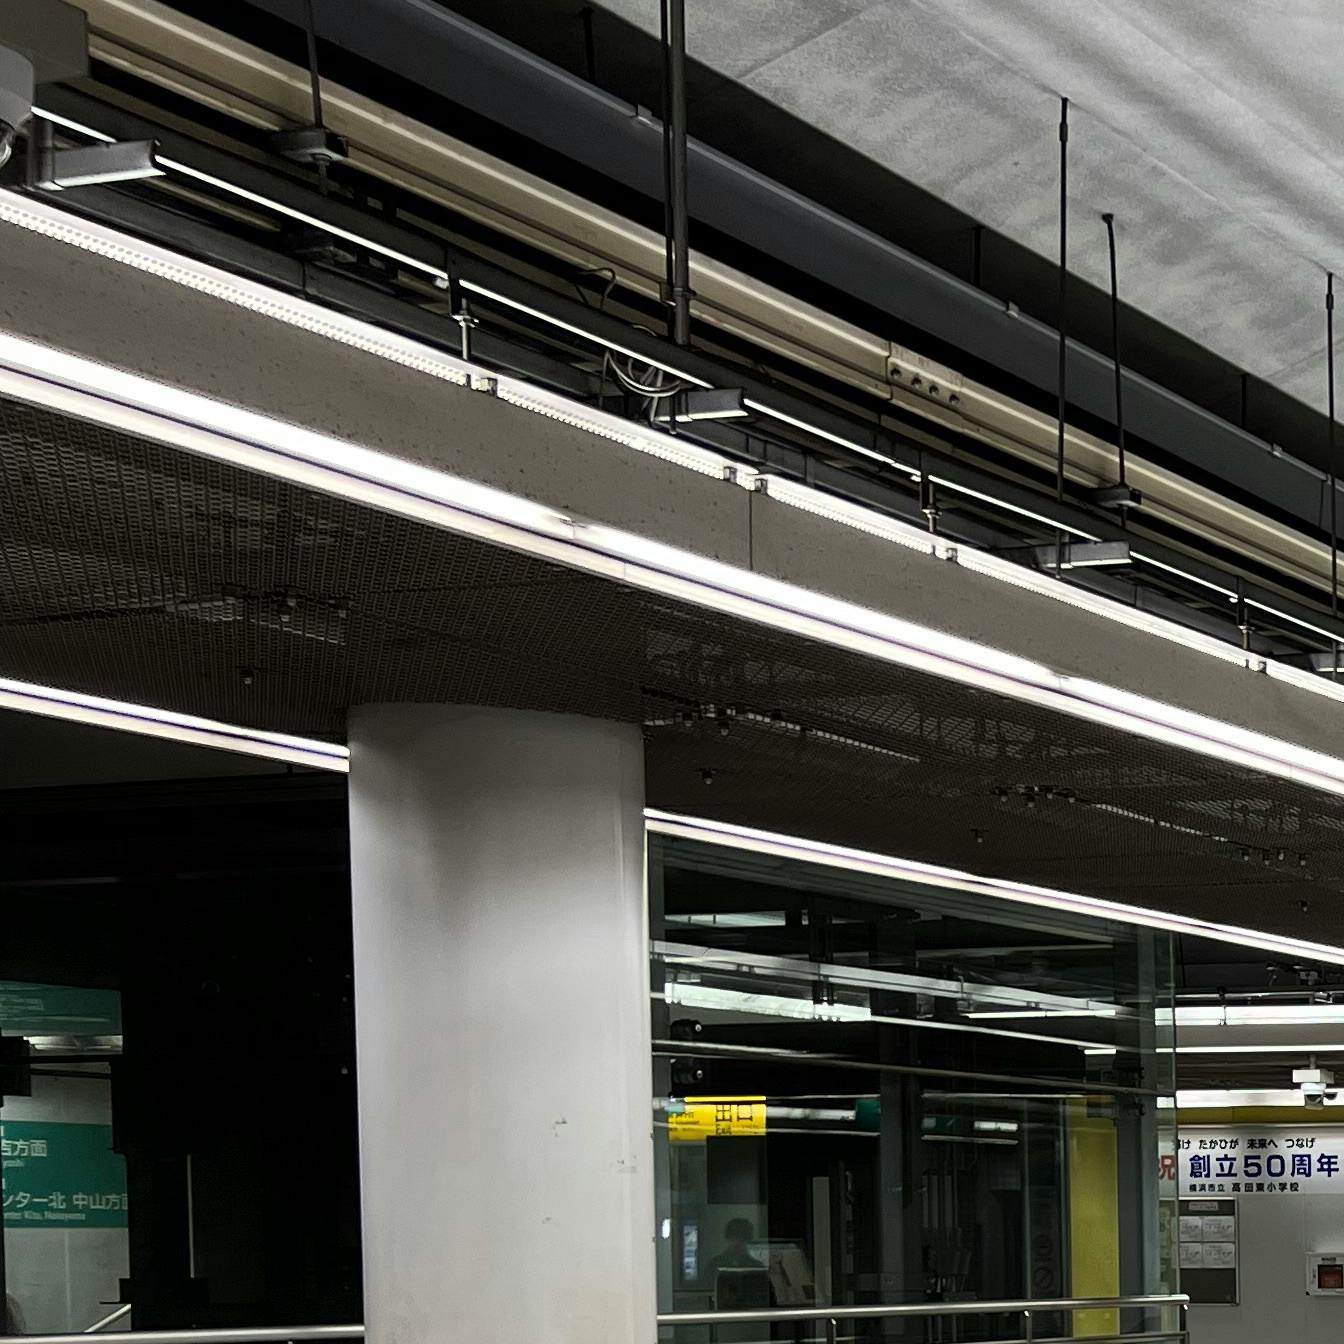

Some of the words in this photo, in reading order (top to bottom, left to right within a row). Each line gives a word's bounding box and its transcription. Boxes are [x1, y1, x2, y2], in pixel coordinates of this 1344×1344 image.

[1199, 1138, 1239, 1150] たかひが
[1247, 1138, 1278, 1150] 未来へ
[1285, 1137, 1315, 1149] つなげ
[1189, 1153, 1339, 1178] 創立50周年
